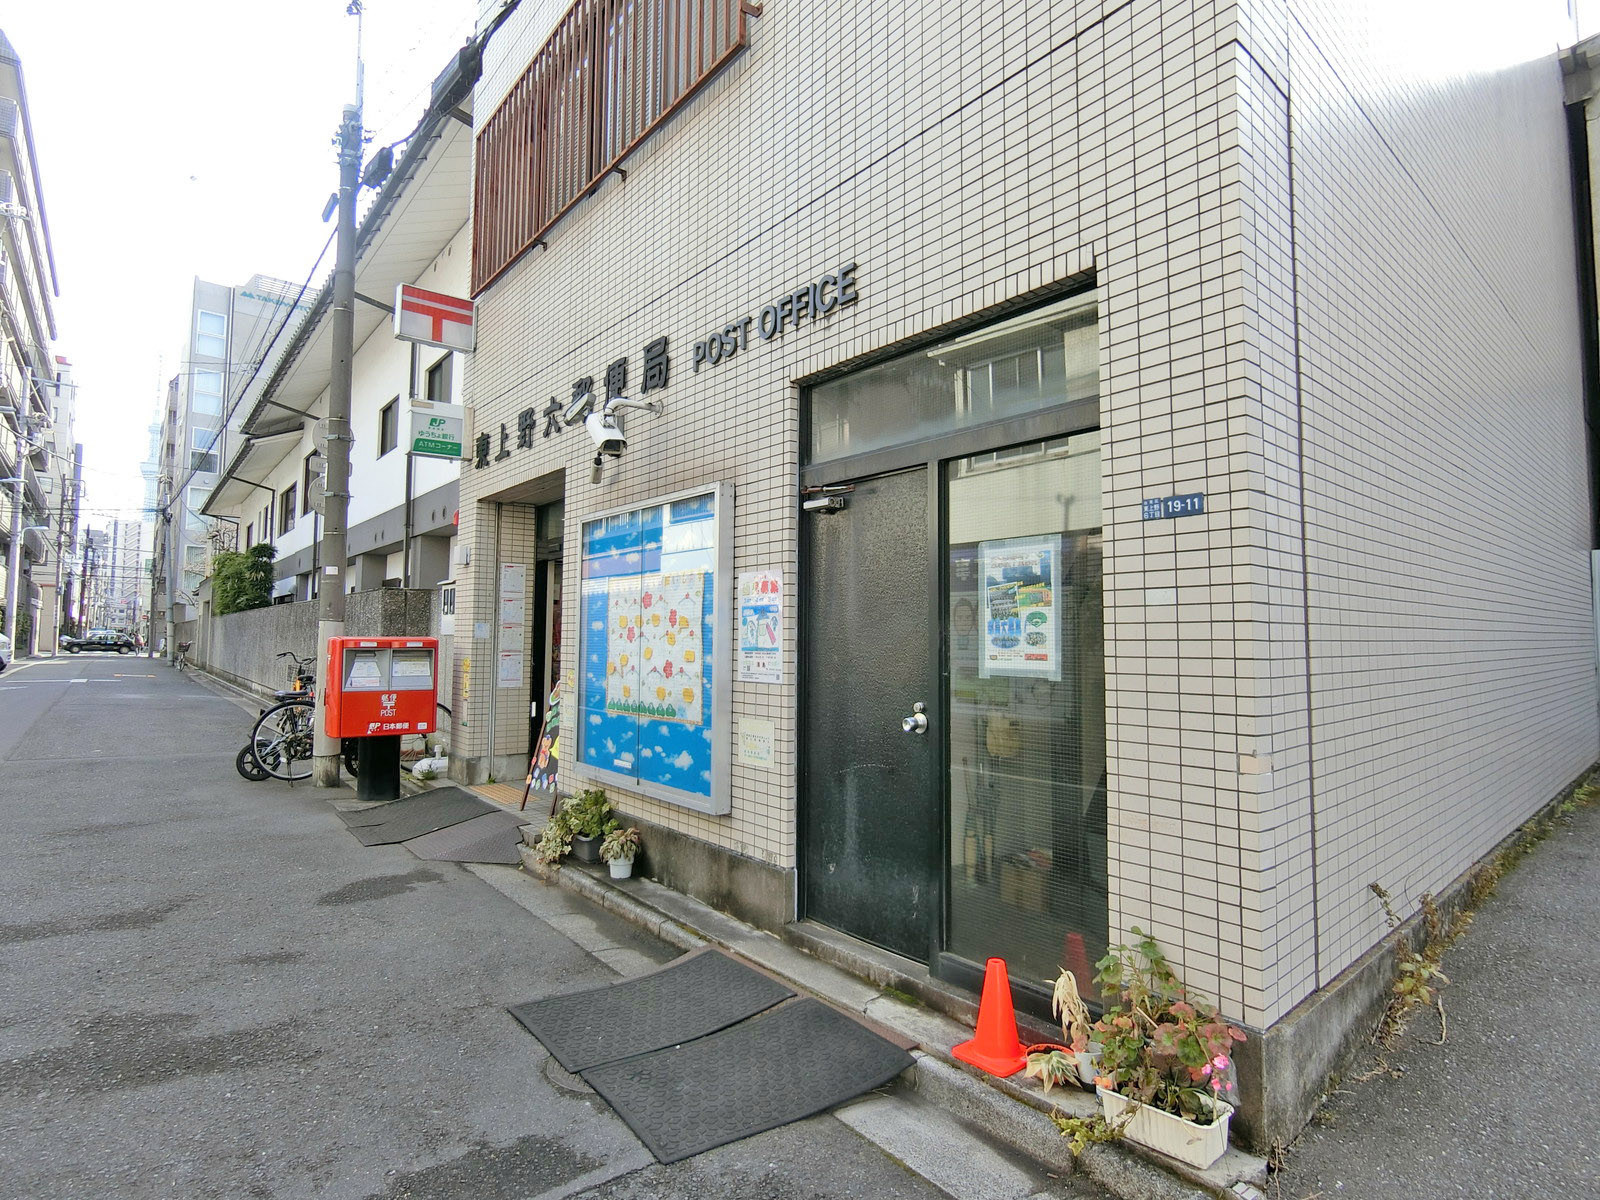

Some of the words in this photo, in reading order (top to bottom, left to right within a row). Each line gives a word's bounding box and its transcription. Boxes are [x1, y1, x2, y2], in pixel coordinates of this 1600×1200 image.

[693, 315, 753, 373] POST
[758, 262, 859, 341] OFFICE
[418, 430, 455, 441] ゆうちょ銀行
[418, 440, 458, 450] ATMコーナー
[1167, 498, 1199, 513] 19-11
